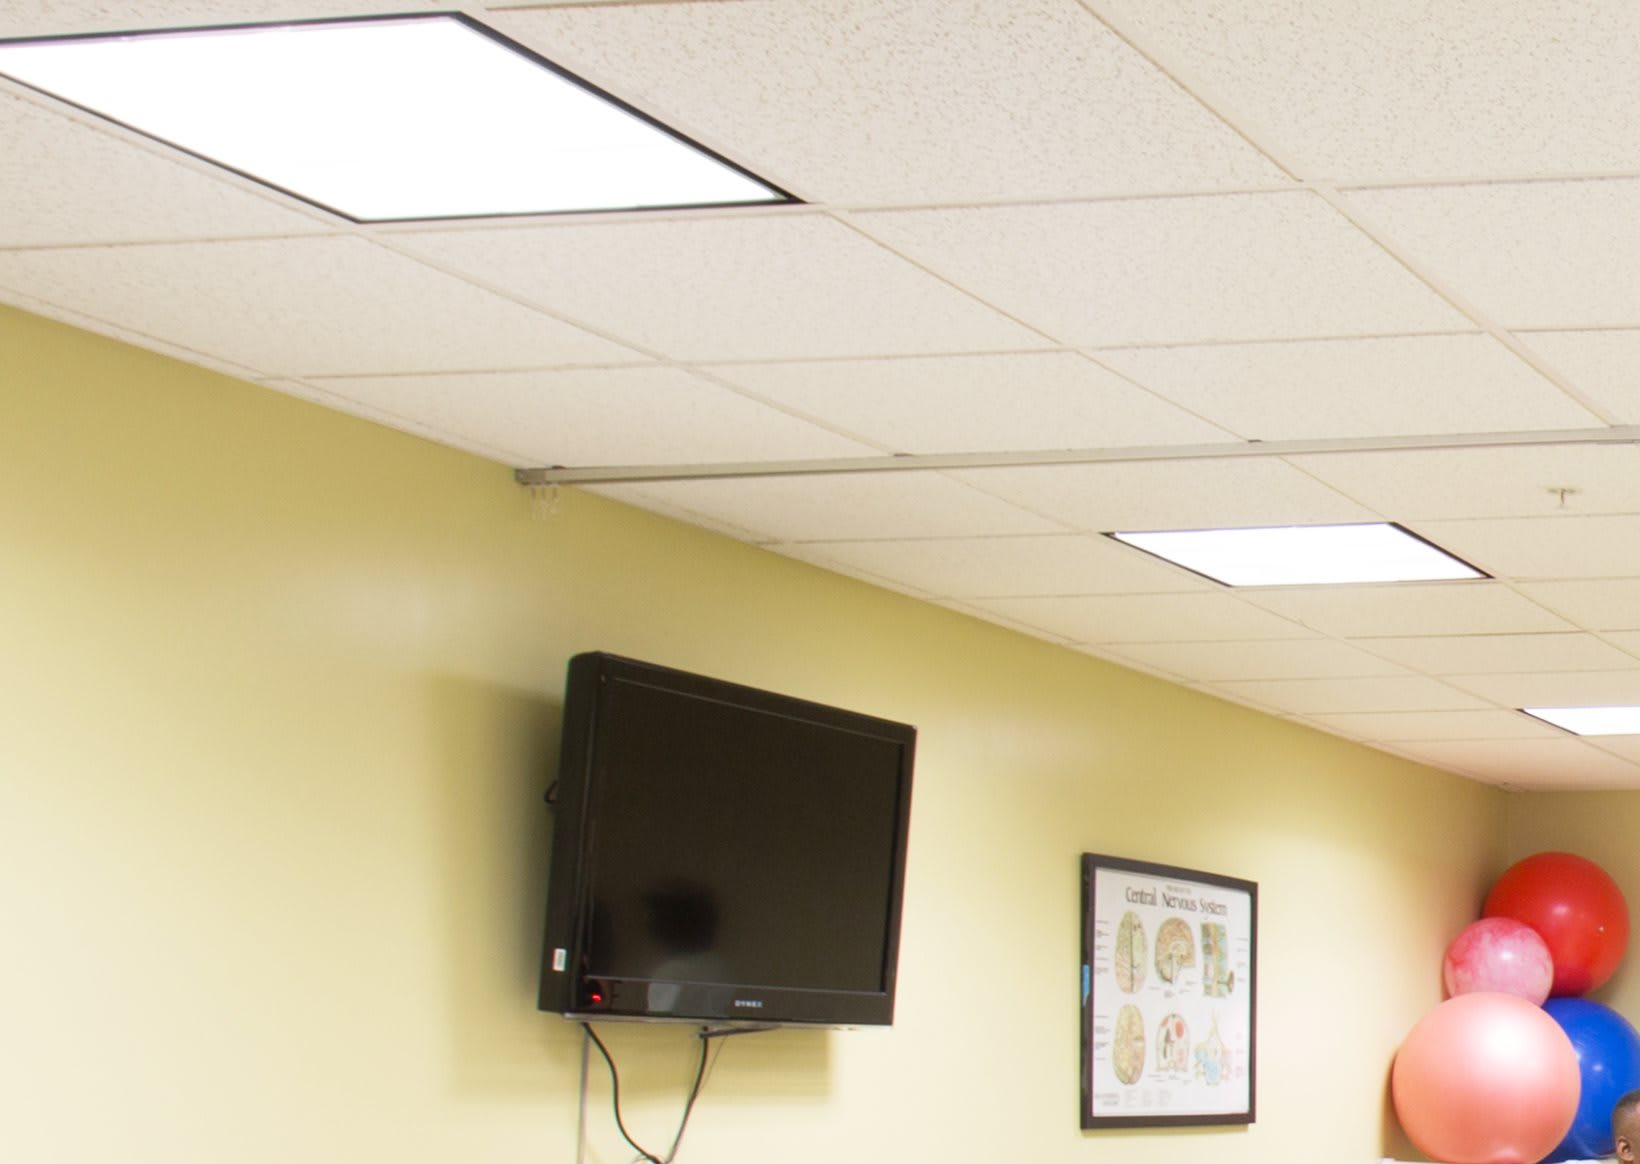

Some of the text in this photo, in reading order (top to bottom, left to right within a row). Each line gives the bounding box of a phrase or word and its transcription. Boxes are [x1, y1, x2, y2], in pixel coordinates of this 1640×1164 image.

[1125, 886, 1158, 907] Central
[1162, 891, 1198, 913] Nervous
[1199, 897, 1228, 921] System
